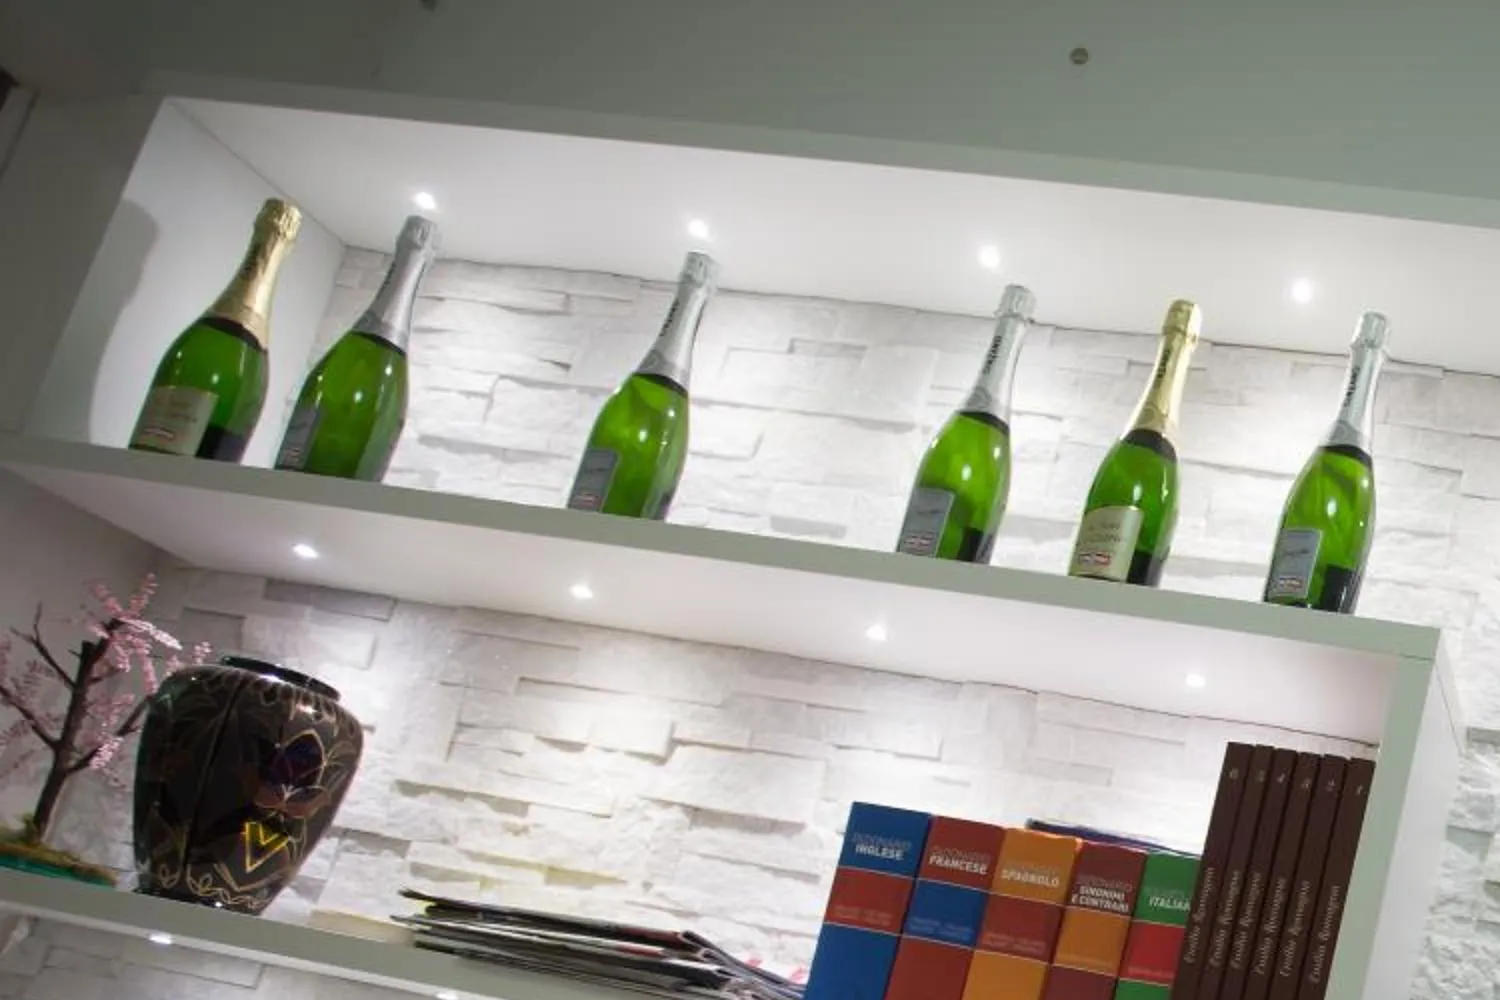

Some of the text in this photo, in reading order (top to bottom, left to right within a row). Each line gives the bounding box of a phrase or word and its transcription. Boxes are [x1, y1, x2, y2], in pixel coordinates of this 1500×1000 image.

[855, 843, 905, 861] INGLESE
[928, 855, 989, 876] FRANCESE
[1002, 867, 1060, 889] SPAGNOLO
[1078, 885, 1126, 900] SINONIMI
[1079, 895, 1129, 913] CONTRARI
[1149, 896, 1191, 912] ITALIA
